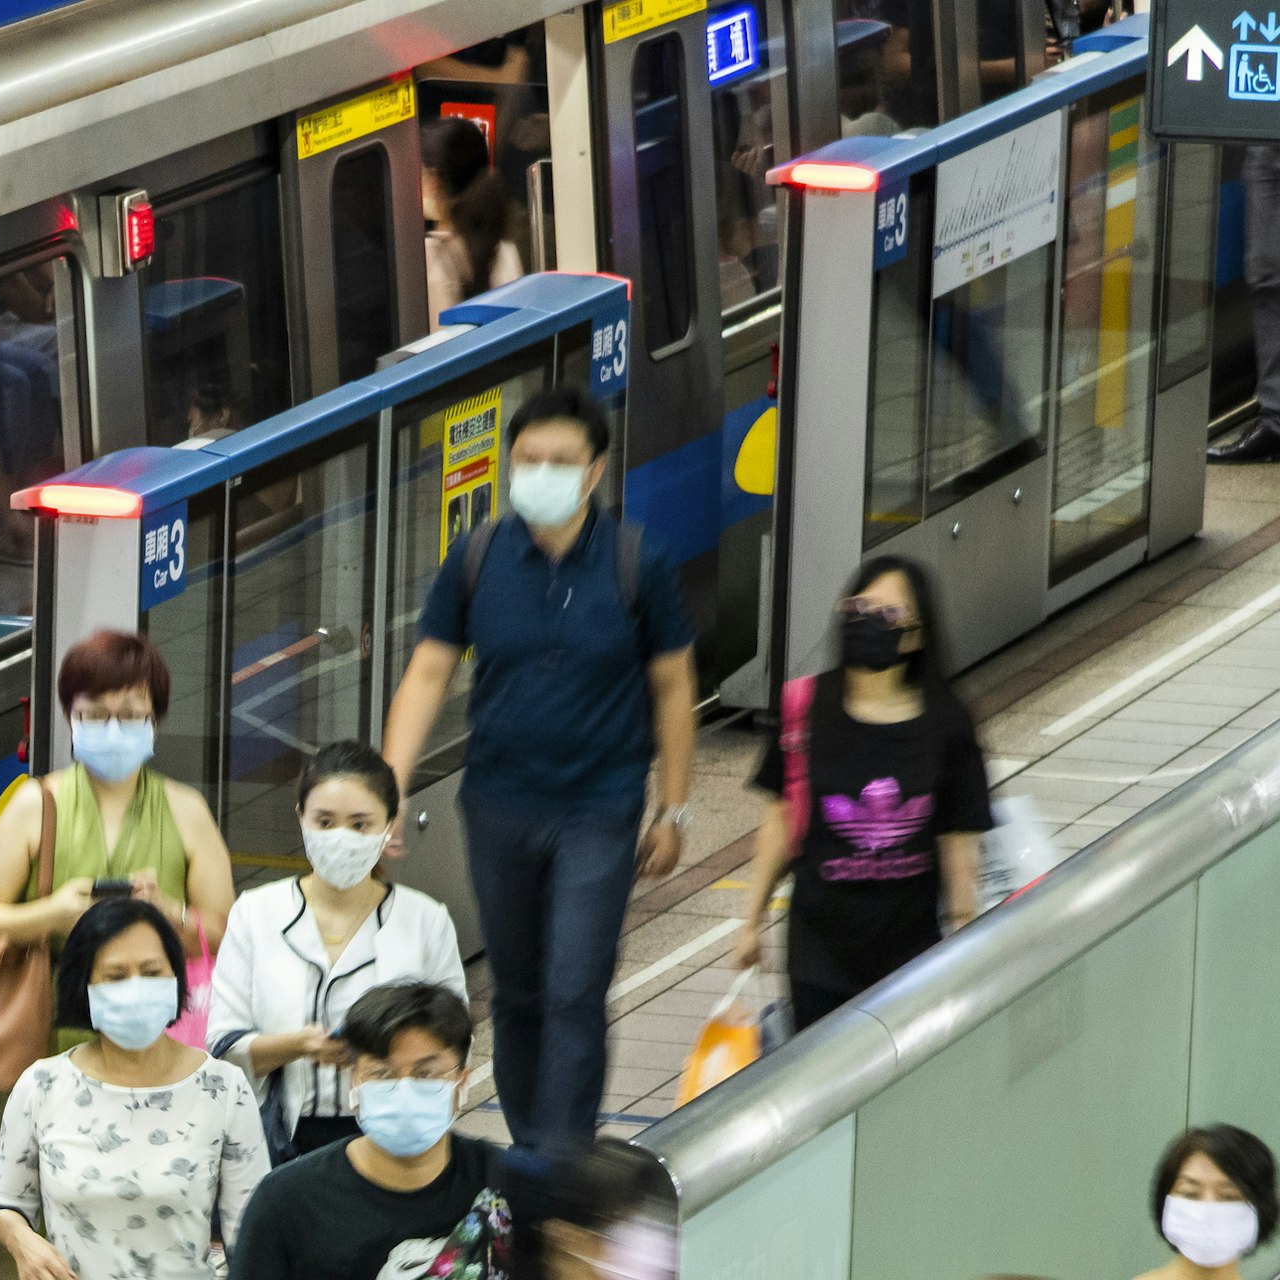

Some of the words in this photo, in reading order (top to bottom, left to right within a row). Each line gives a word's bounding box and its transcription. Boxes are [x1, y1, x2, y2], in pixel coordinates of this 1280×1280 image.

[895, 193, 906, 246] 3
[592, 323, 613, 361] 車廂
[613, 319, 627, 376] 3
[600, 365, 612, 383] Car
[144, 524, 169, 565] 車廂
[169, 518, 184, 581] 3
[153, 569, 168, 589] Car
